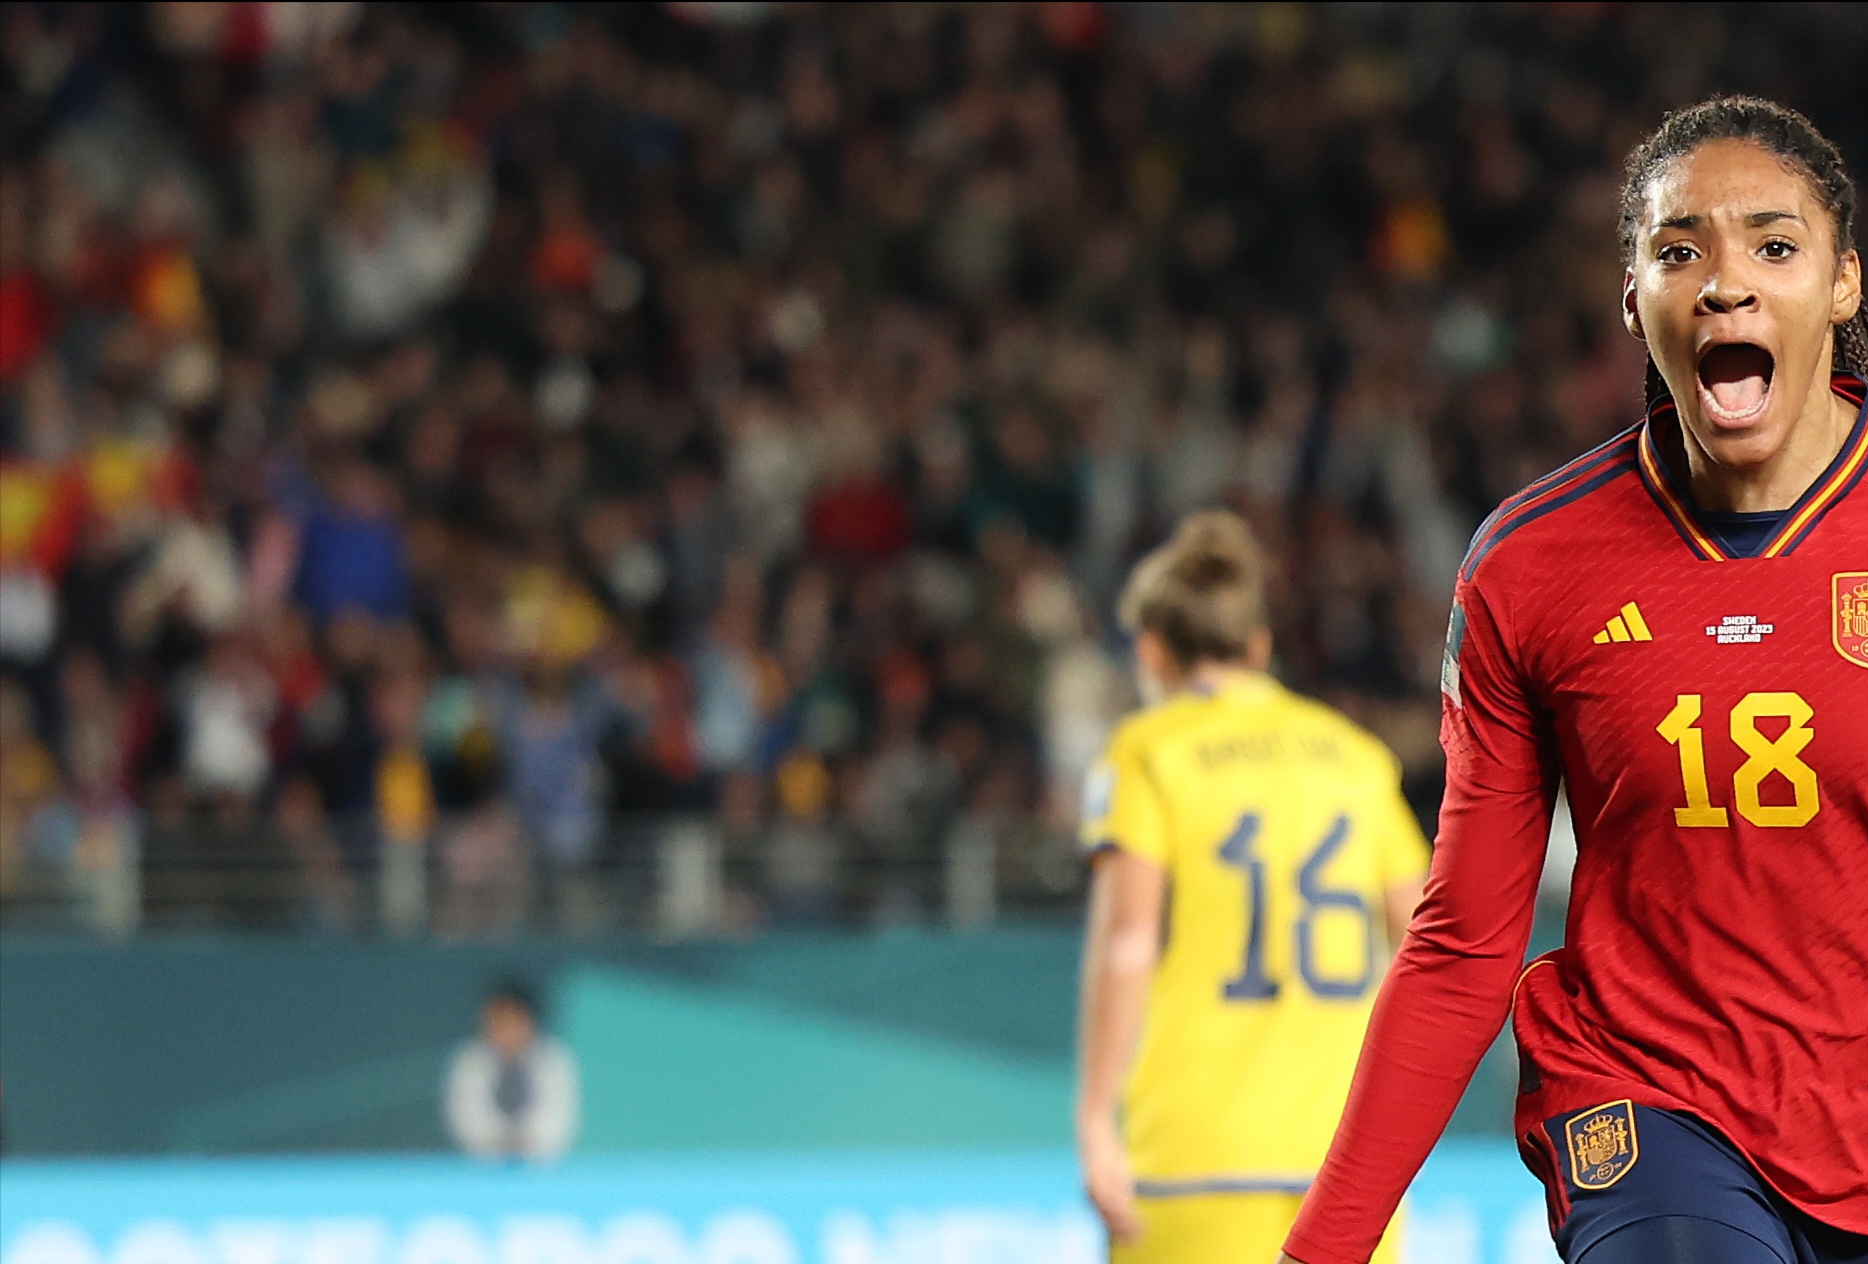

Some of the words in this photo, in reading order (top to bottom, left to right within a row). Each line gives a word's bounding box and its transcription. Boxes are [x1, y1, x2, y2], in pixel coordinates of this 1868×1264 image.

[1723, 616, 1757, 625] SWEDEN
[1706, 626, 1716, 635] 15
[1717, 625, 1750, 635] AUGUST
[1750, 624, 1773, 634] 2023
[1717, 634, 1761, 644] AUCKLAND
[1655, 691, 1821, 828] 18
[1217, 813, 1372, 1001] 16
